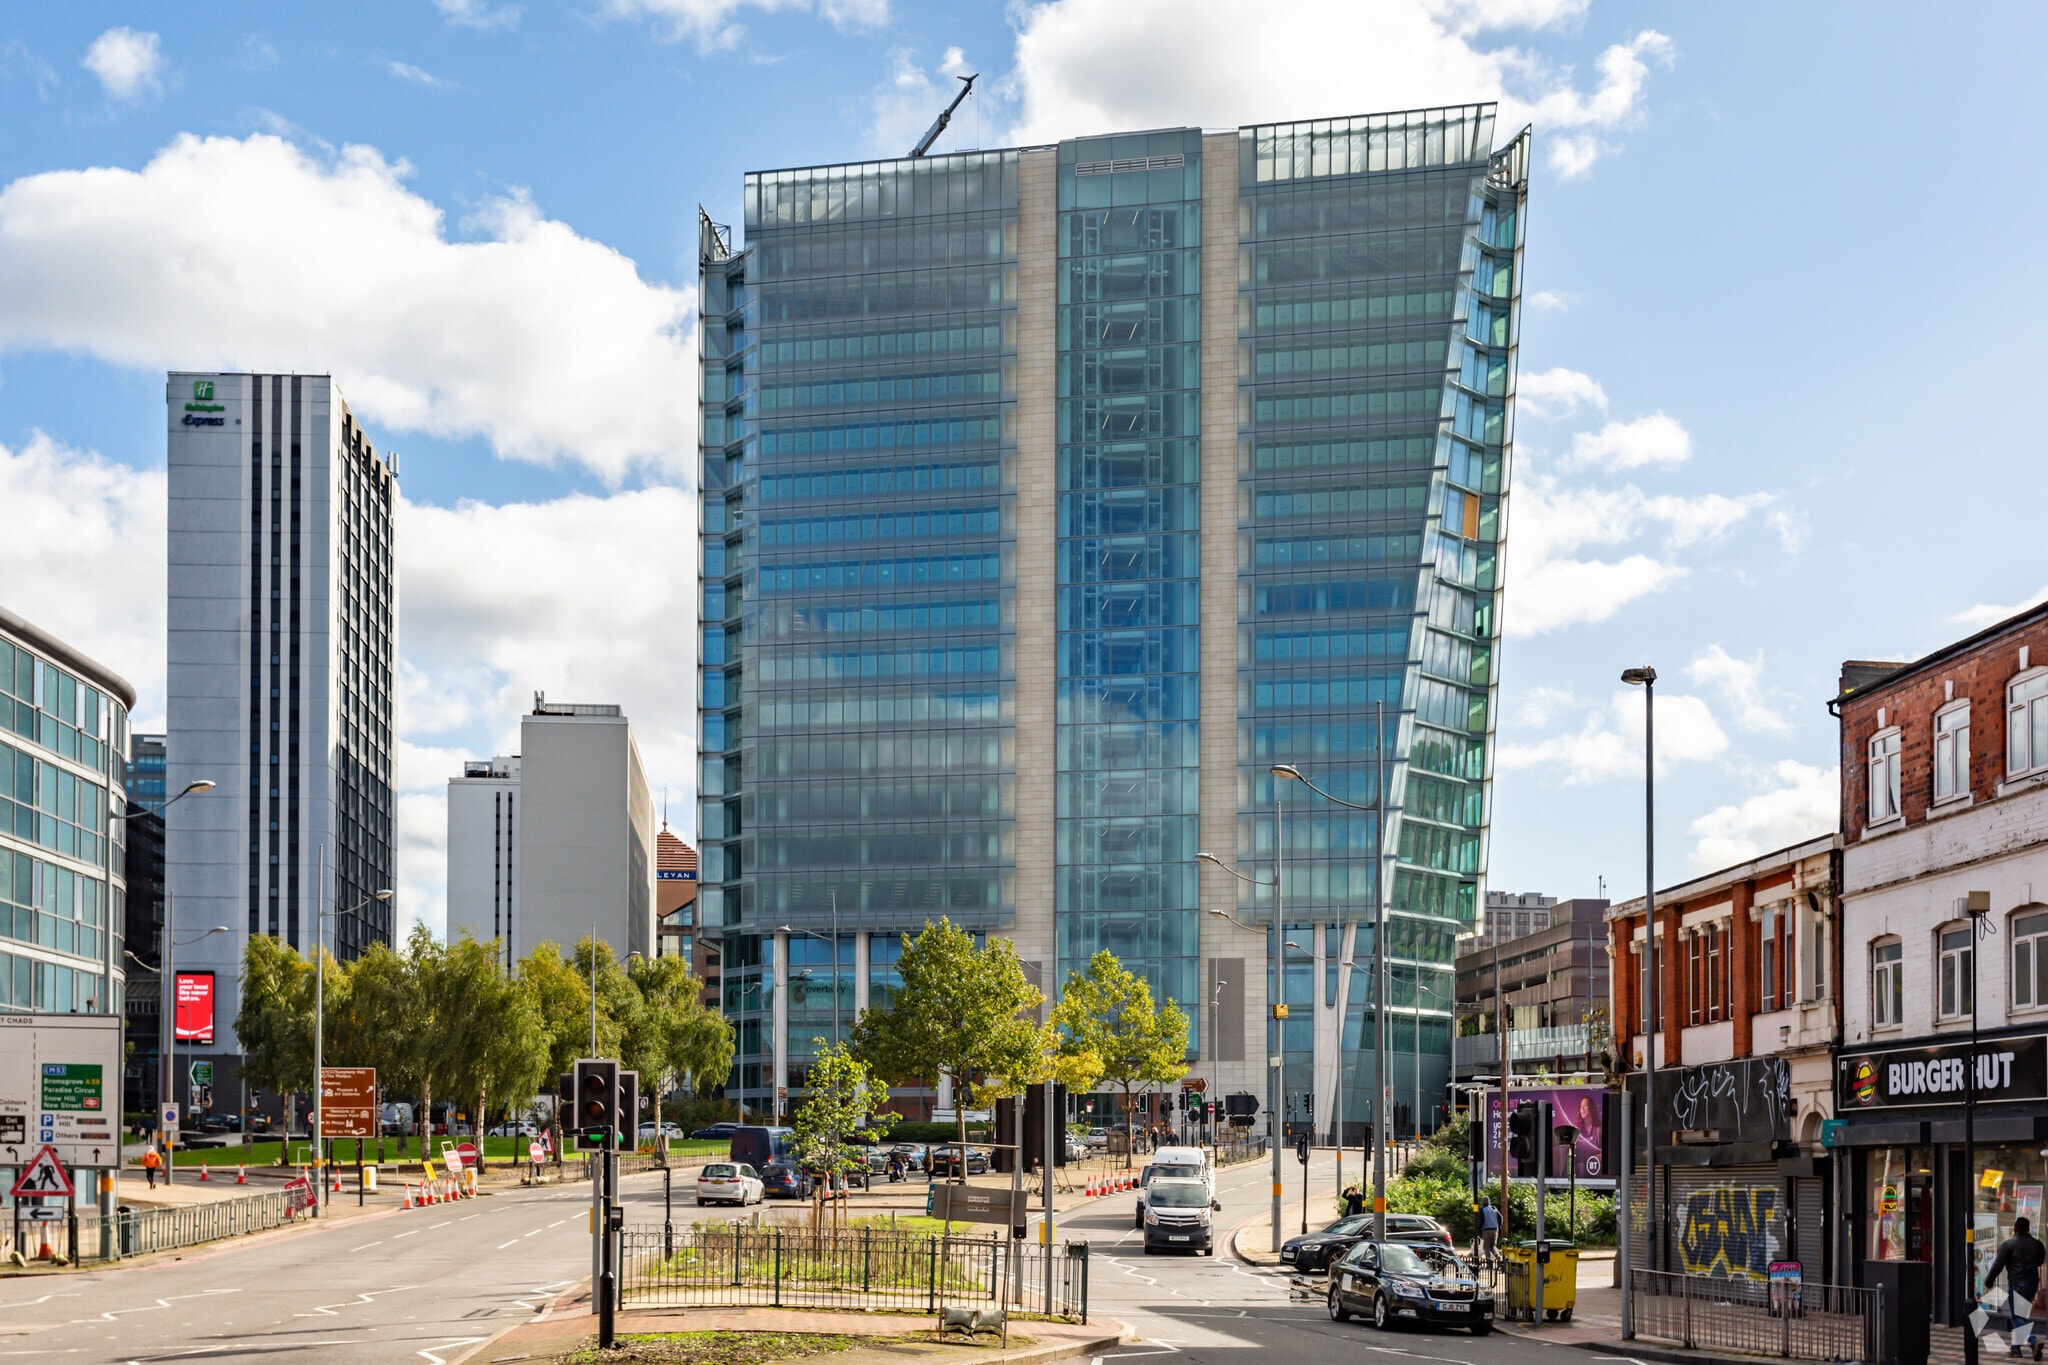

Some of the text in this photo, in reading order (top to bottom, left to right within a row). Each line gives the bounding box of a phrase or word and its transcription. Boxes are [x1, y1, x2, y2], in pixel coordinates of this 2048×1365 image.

[44, 1066, 65, 1075] (M5)
[1888, 1058, 1964, 1096] BURGER
[1971, 1052, 2015, 1090] HUT
[43, 1078, 84, 1086] Bromsgrove
[43, 1115, 52, 1126] P
[43, 1130, 52, 1141] P
[1589, 1161, 1597, 1170] BT
